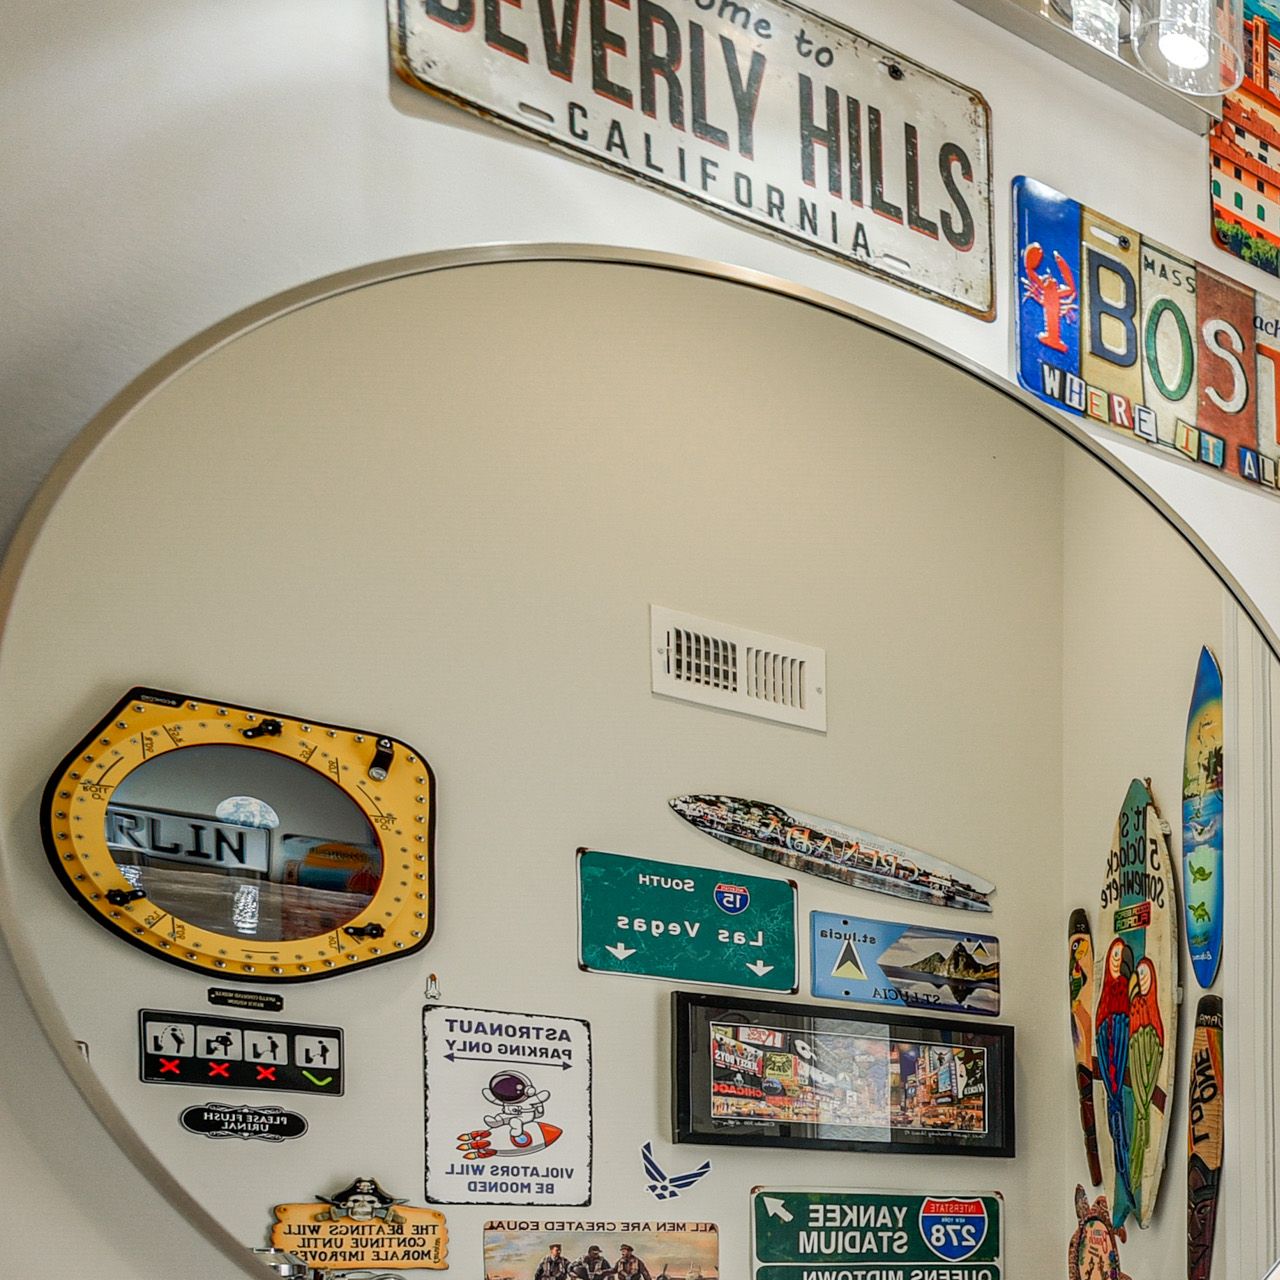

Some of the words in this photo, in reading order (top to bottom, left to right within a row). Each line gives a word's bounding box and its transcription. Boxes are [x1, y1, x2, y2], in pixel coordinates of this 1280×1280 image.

[794, 28, 835, 69] to
[568, 101, 874, 260] CALIFORNIA
[798, 70, 975, 254] HILLS
[1142, 254, 1197, 294] MASS
[1041, 363, 1158, 444] WHERE
[1177, 421, 1225, 468] IT
